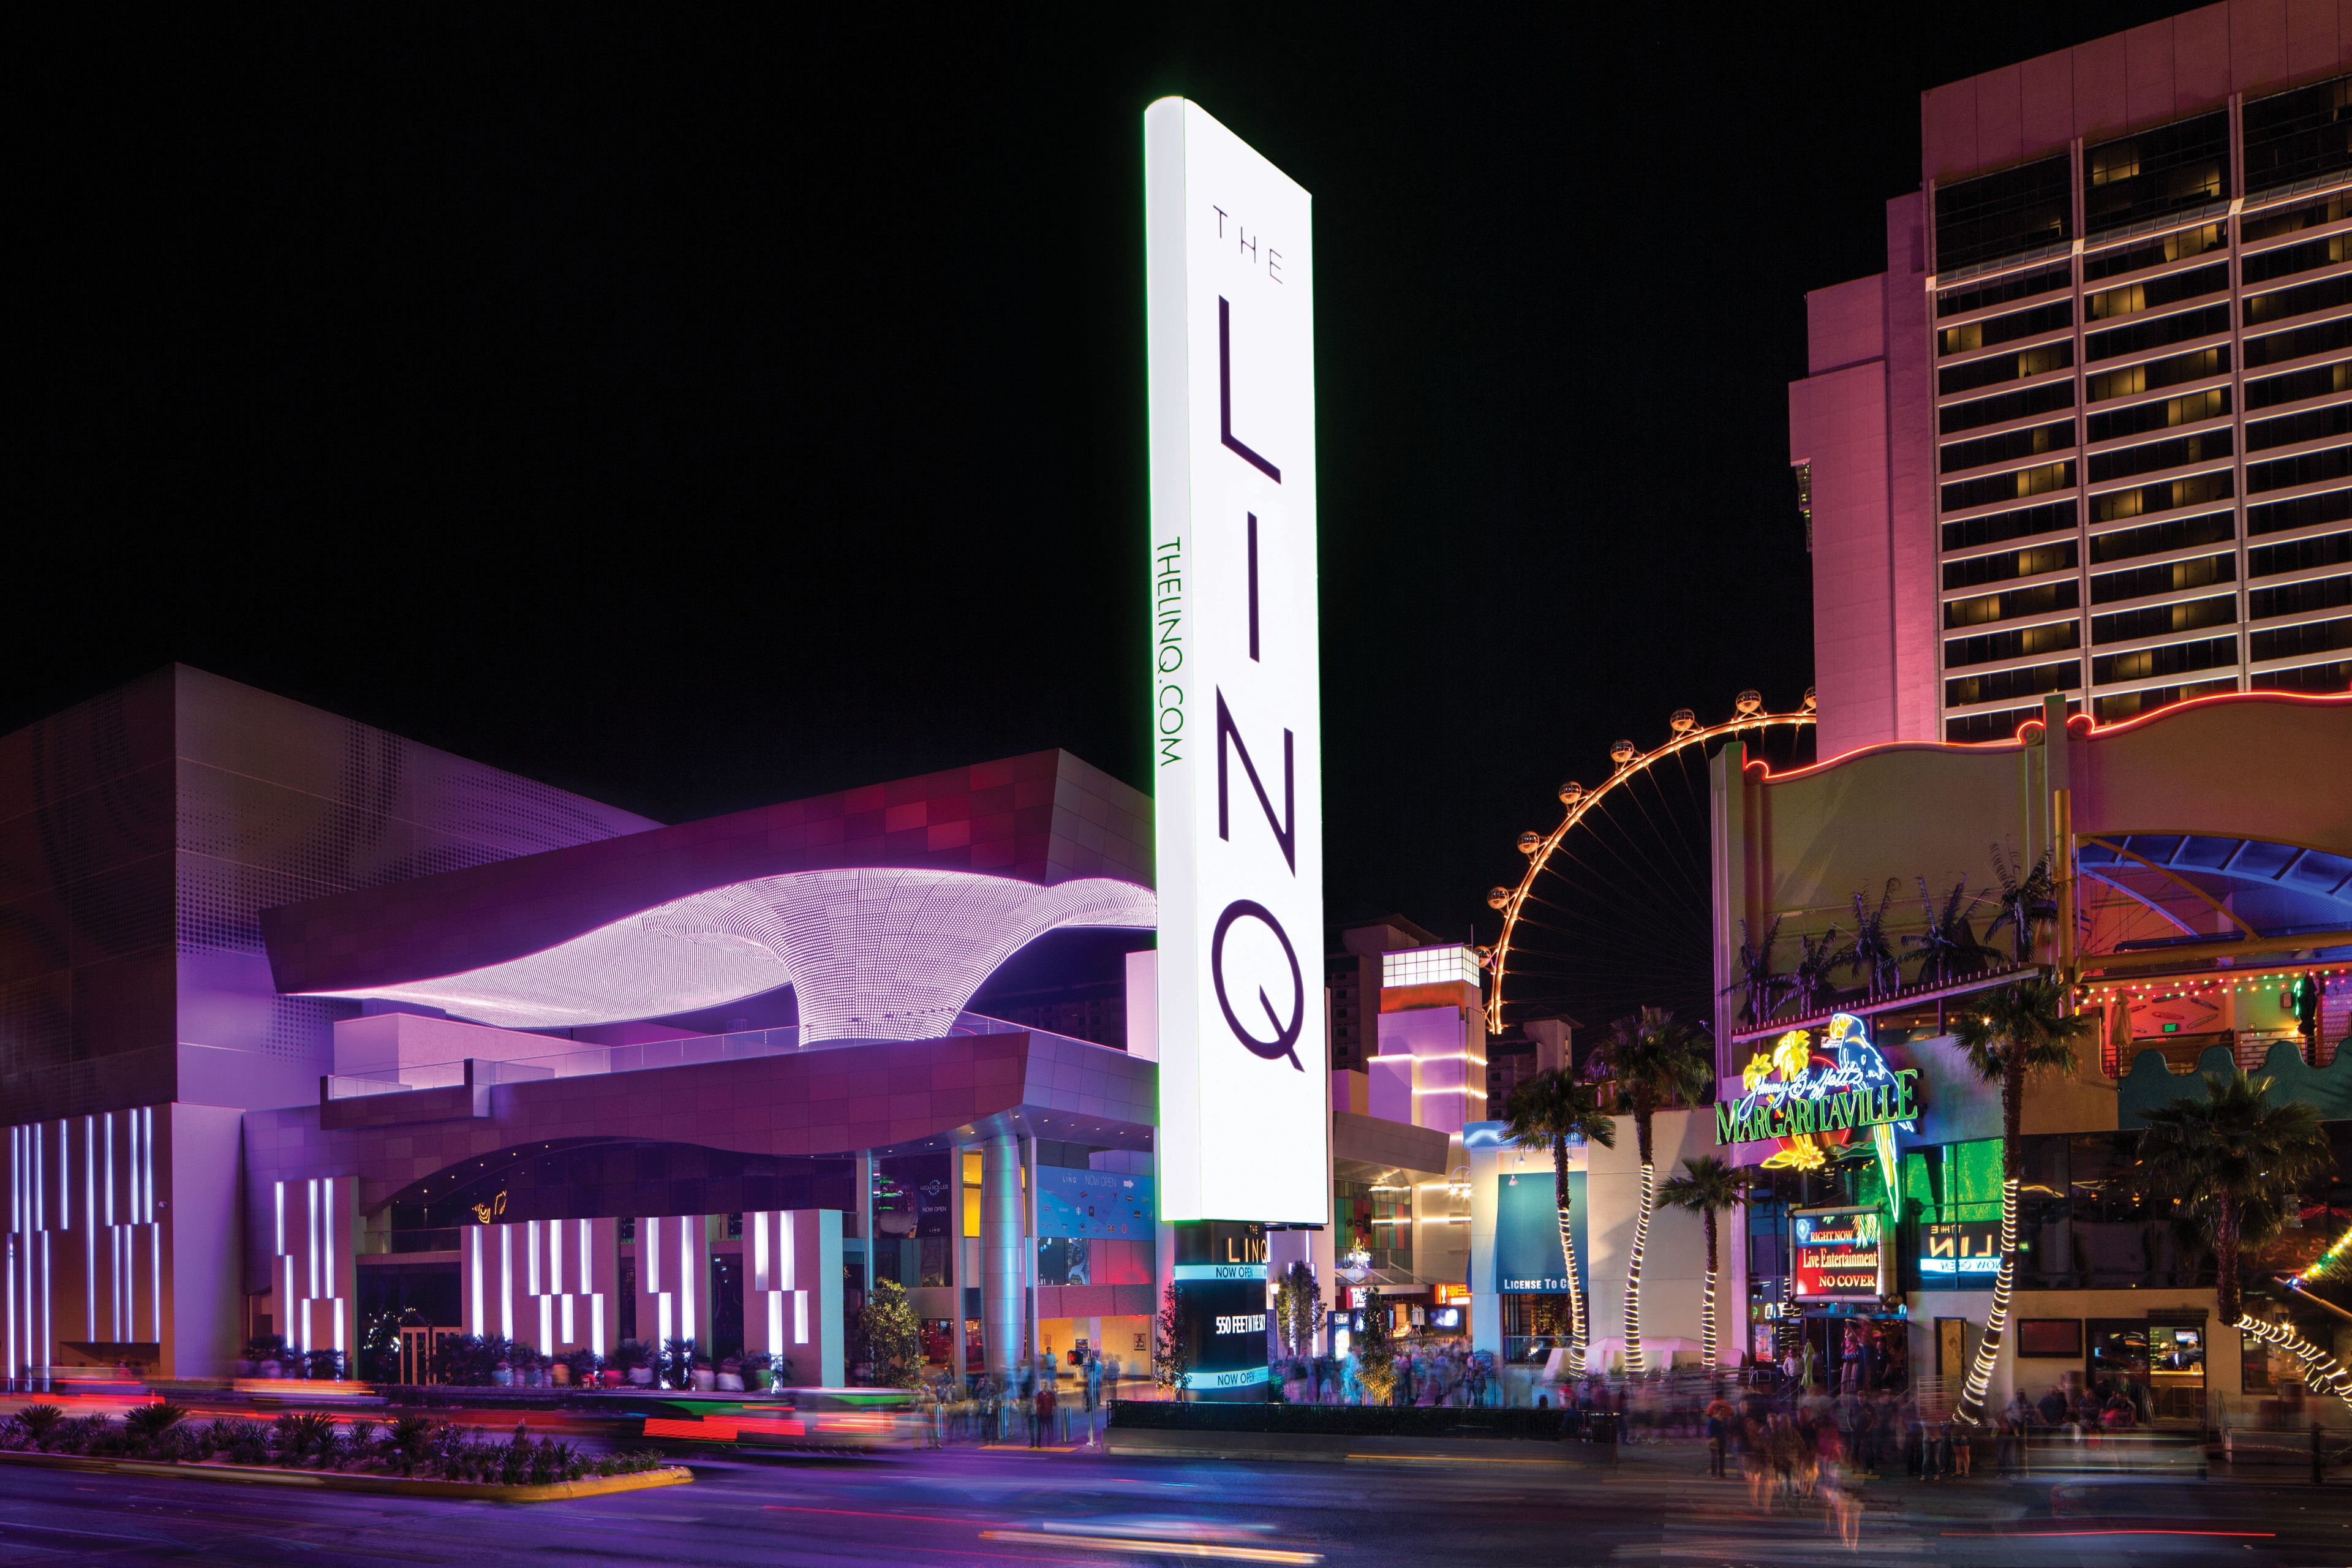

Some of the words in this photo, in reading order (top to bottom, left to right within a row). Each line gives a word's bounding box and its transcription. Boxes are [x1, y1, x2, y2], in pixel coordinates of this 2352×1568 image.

[1213, 205, 1283, 284] THE
[1157, 536, 1184, 767] THELINQ.COM
[1211, 293, 1306, 1073] LINQ
[1714, 1069, 1919, 1145] MARGARITAVILLE
[1738, 1076, 1789, 1121] Jimmy
[1085, 1175, 1099, 1186] NOW
[1101, 1175, 1117, 1188] OPEN
[1250, 1225, 1258, 1235] THE
[1810, 1231, 1834, 1242] RIGHT
[1834, 1230, 1853, 1242] NOW
[1228, 1237, 1267, 1264] LINQ
[1803, 1248, 1820, 1268] Live
[1820, 1248, 1878, 1268] Entertainment
[1216, 1267, 1237, 1278] NOW
[1238, 1267, 1253, 1278] OPEN
[1819, 1275, 1836, 1287] NO
[1837, 1275, 1876, 1287] COVER
[1504, 1279, 1542, 1289] LICENSE
[1216, 1316, 1232, 1334] 550
[1232, 1315, 1248, 1333] FEET
[1217, 1373, 1238, 1386] NOW
[1240, 1371, 1255, 1384] OPEN
